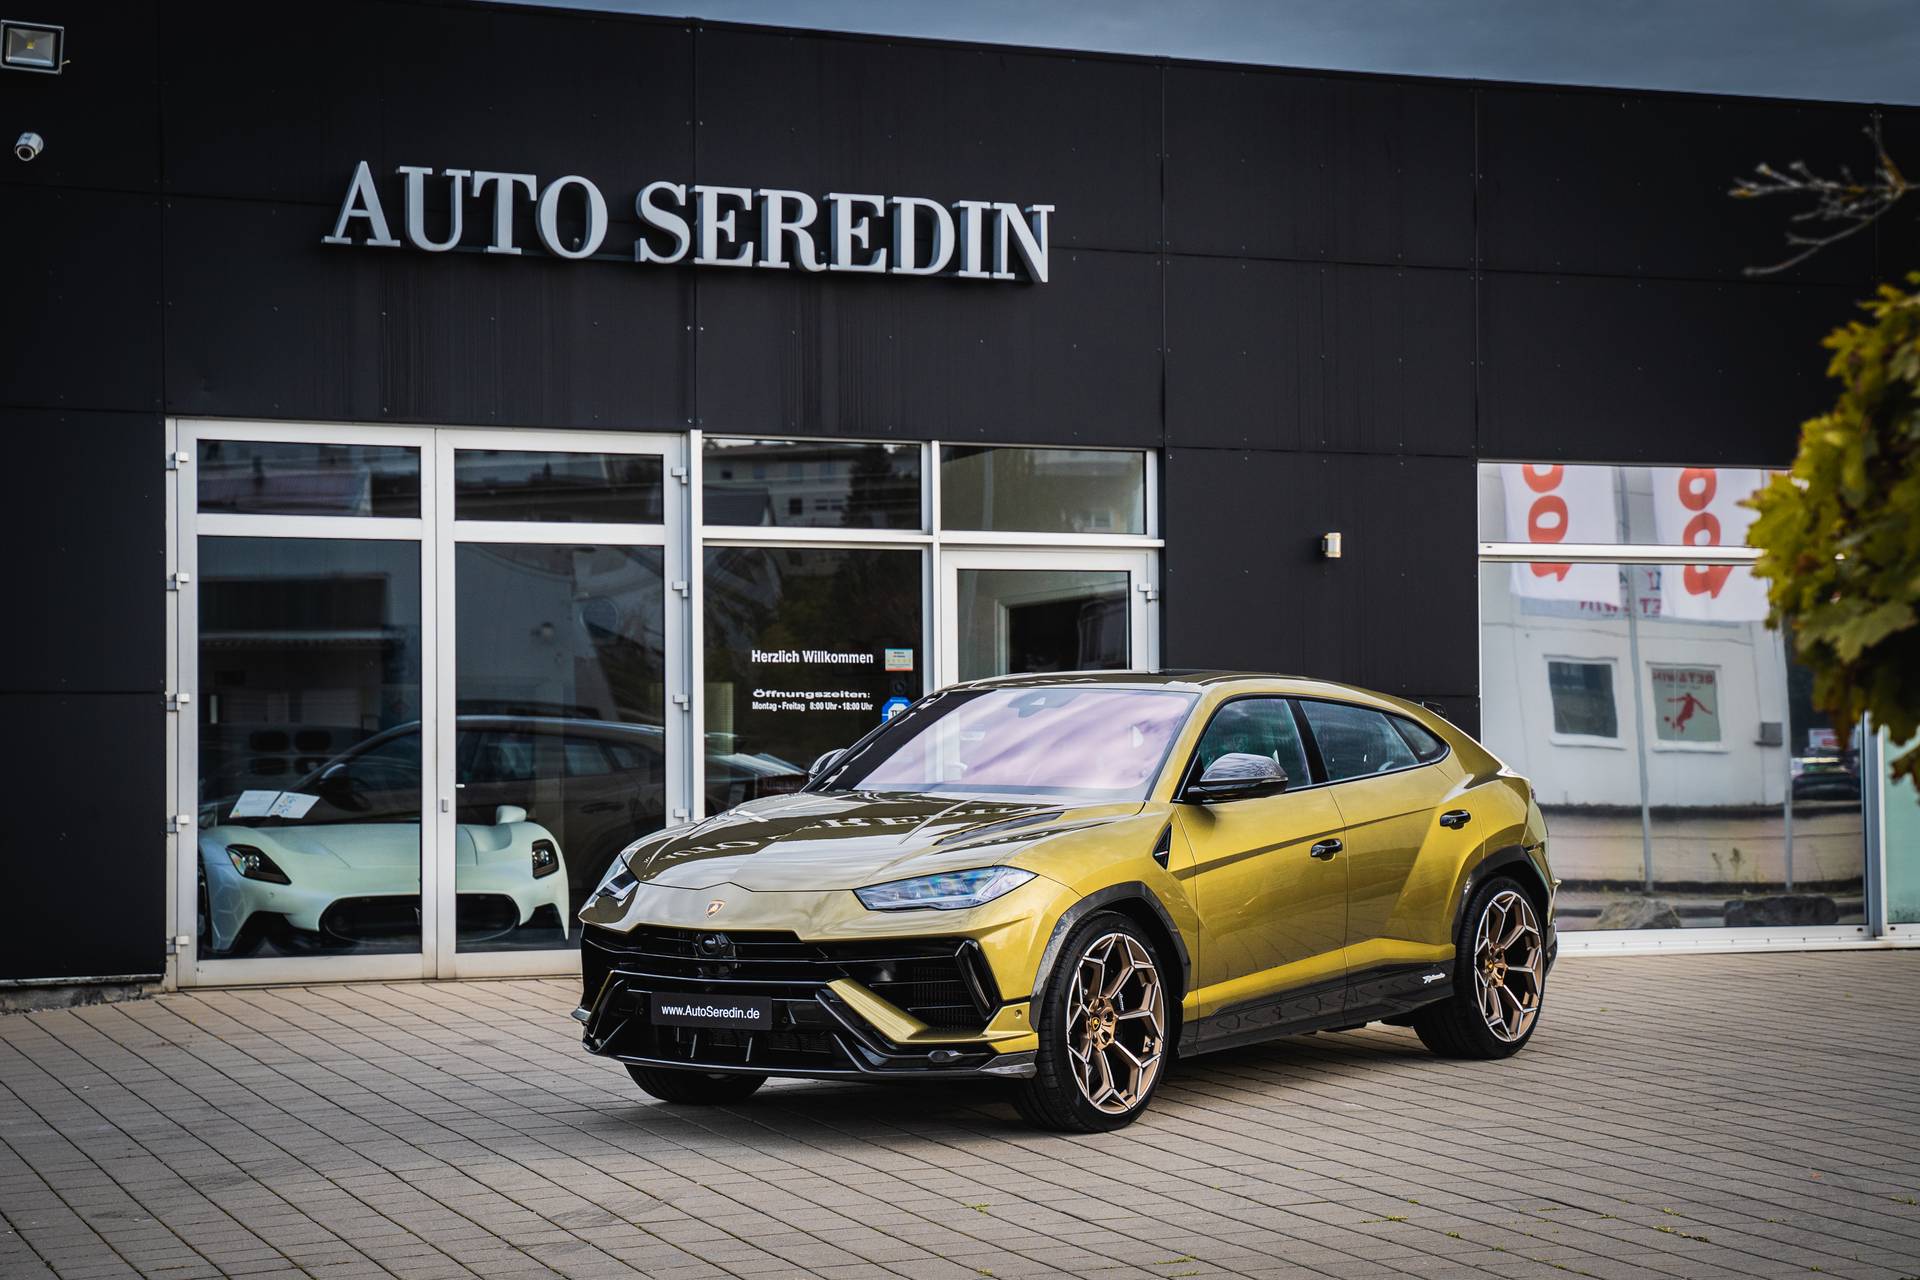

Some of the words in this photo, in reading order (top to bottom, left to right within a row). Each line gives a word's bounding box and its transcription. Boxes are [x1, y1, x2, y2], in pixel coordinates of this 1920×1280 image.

[321, 160, 608, 260] AUTO
[635, 181, 1056, 284] SEREDIN
[751, 650, 800, 663] Herzlich
[802, 650, 874, 664] Willkommen
[752, 689, 871, 700] Öffnungszeiten:
[752, 701, 777, 712] Montag
[782, 702, 805, 712] Freitag
[809, 702, 824, 710] 8:00
[825, 702, 837, 710] Uhr
[842, 702, 860, 711] 18:00
[861, 702, 873, 711] Uhr
[661, 1004, 760, 1020] www.AutoSeredin.de
